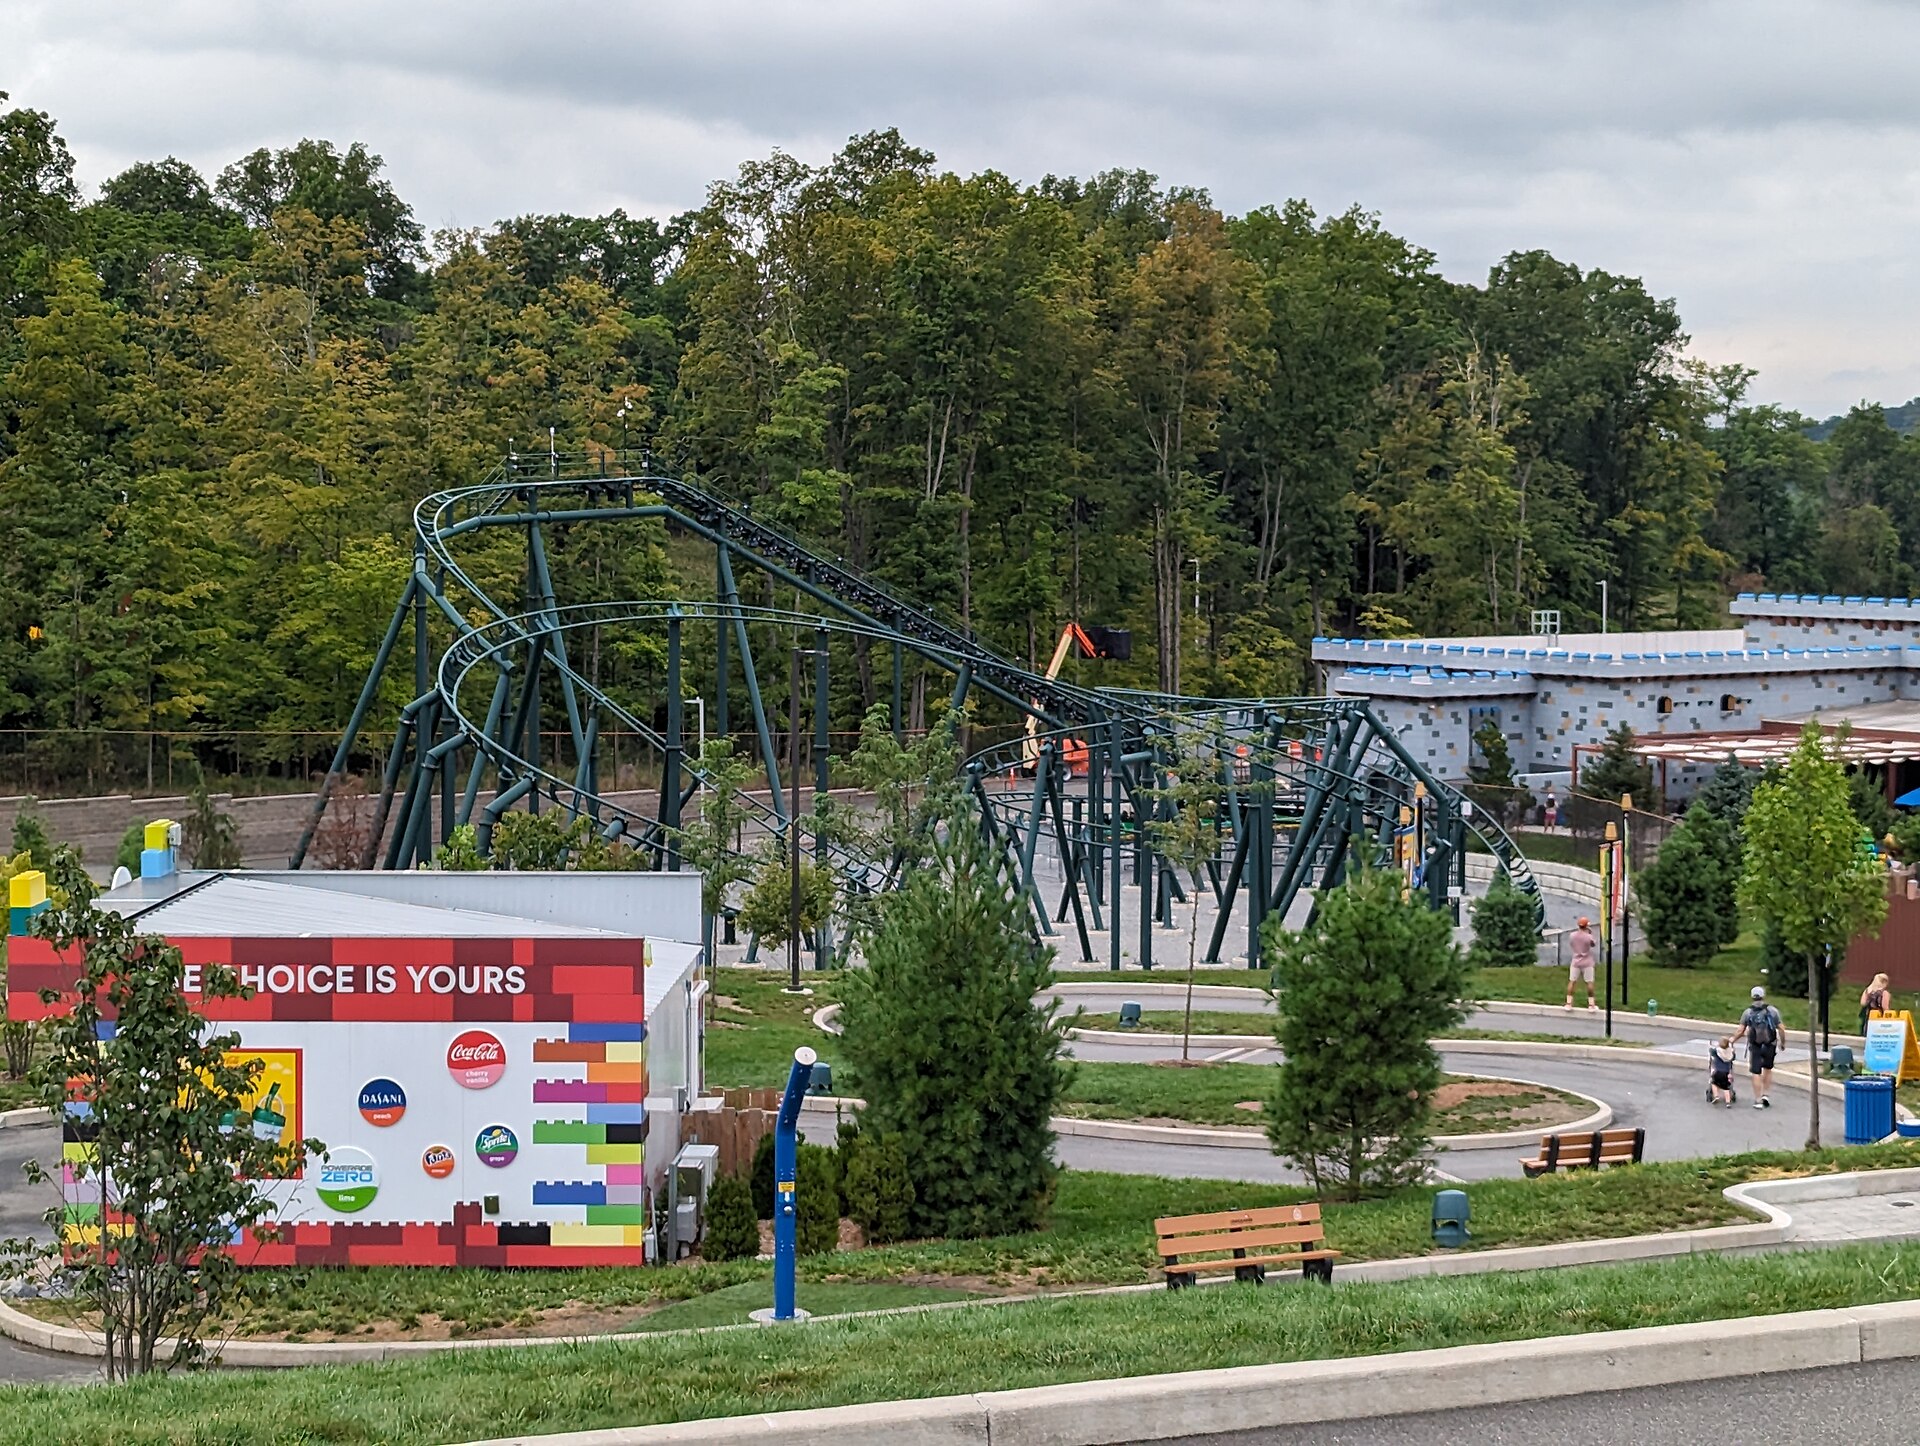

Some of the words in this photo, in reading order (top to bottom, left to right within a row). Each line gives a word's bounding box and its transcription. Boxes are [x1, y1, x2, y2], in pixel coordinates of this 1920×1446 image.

[222, 964, 354, 994] HOICE
[366, 965, 397, 994] IS
[405, 965, 526, 994] YOURS
[362, 1091, 402, 1106] DASANI
[482, 1133, 508, 1149] Sprite
[321, 1171, 373, 1182] ZERO
[338, 1194, 356, 1202] lime
